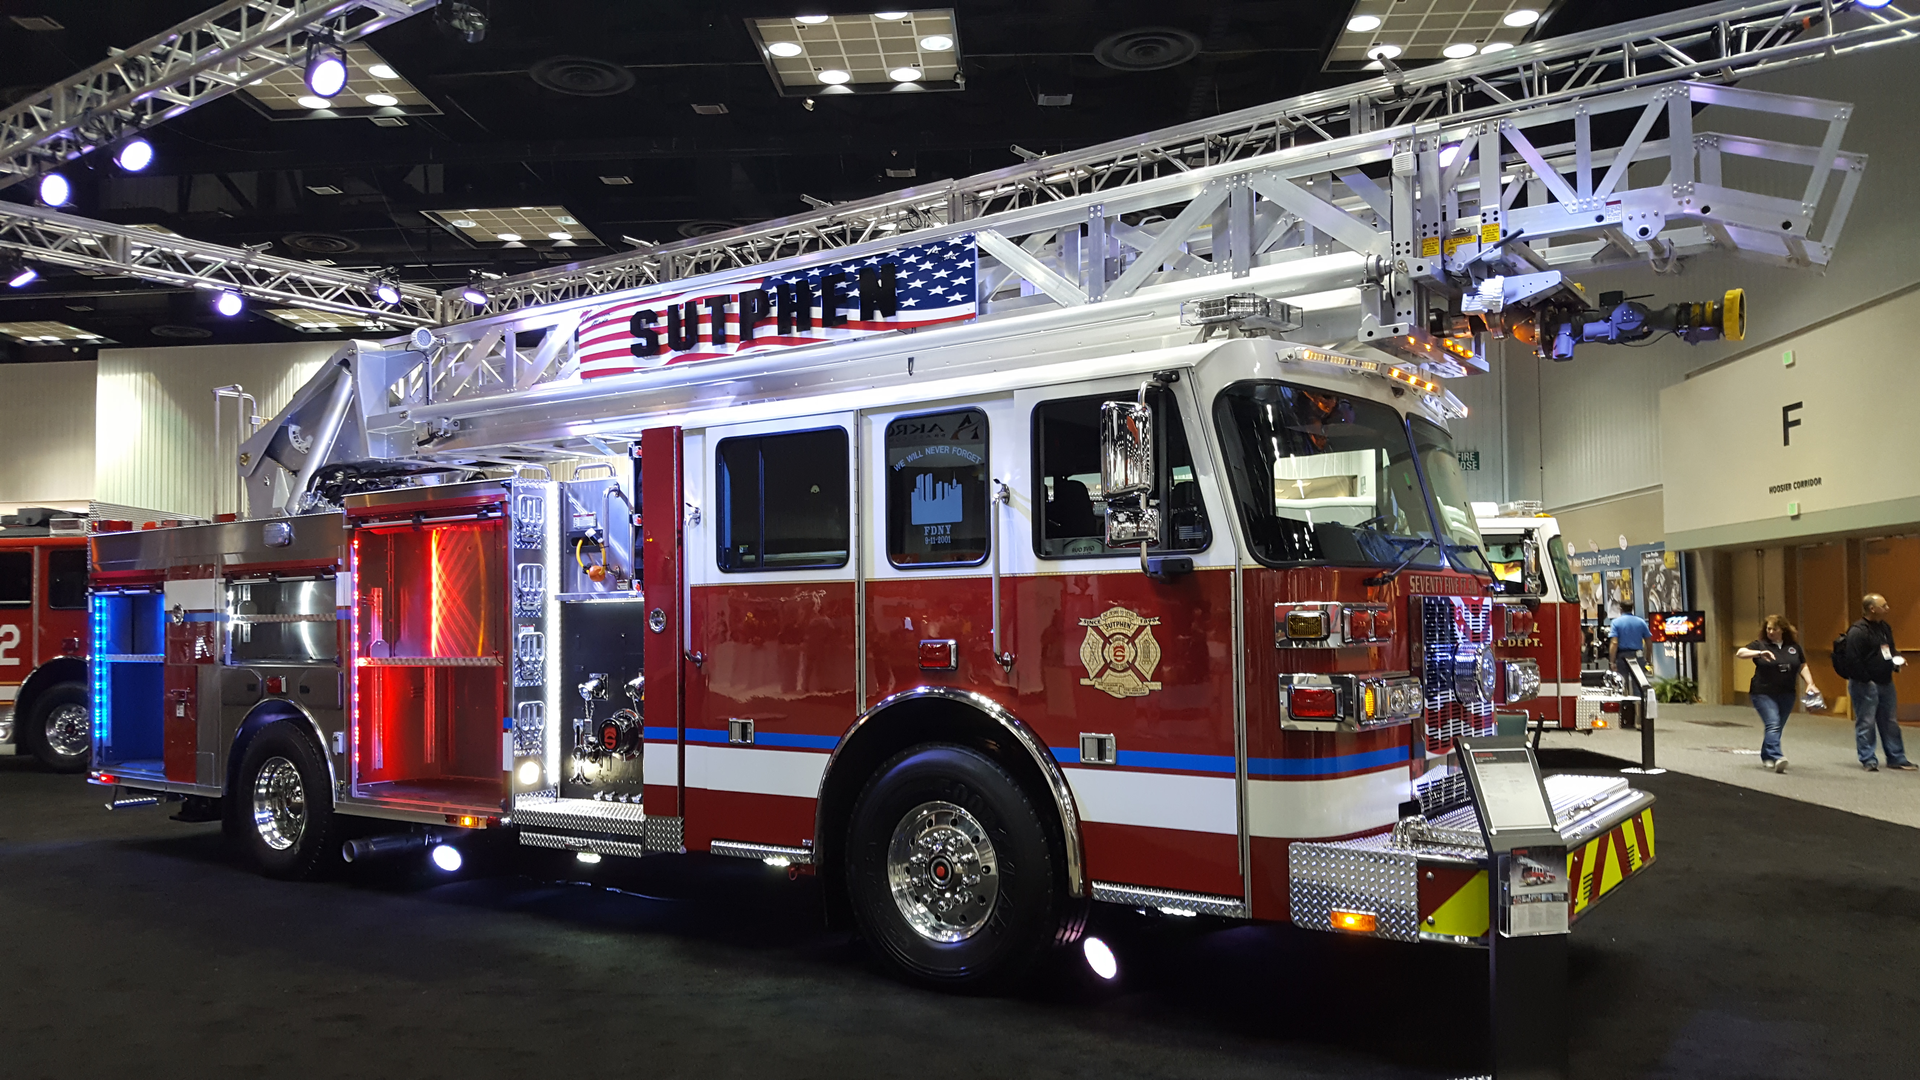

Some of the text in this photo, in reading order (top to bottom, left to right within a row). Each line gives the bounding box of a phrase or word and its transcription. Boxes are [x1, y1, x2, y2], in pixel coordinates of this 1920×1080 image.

[629, 262, 897, 358] SUTPHEN
[1782, 401, 1803, 447] F
[893, 445, 982, 472] WE WILL NEVER FORGET
[1456, 452, 1475, 461] FIRE
[1459, 461, 1477, 470] OSE
[1768, 477, 1822, 494] HOOSIER CORRIDOR
[923, 524, 952, 536] FDNY
[1409, 575, 1444, 594] SEVENTY
[1444, 575, 1459, 594] FIVE
[1105, 621, 1131, 629] SUTPHEN
[0, 624, 20, 665] 2
[1507, 638, 1543, 648] DEPT.
